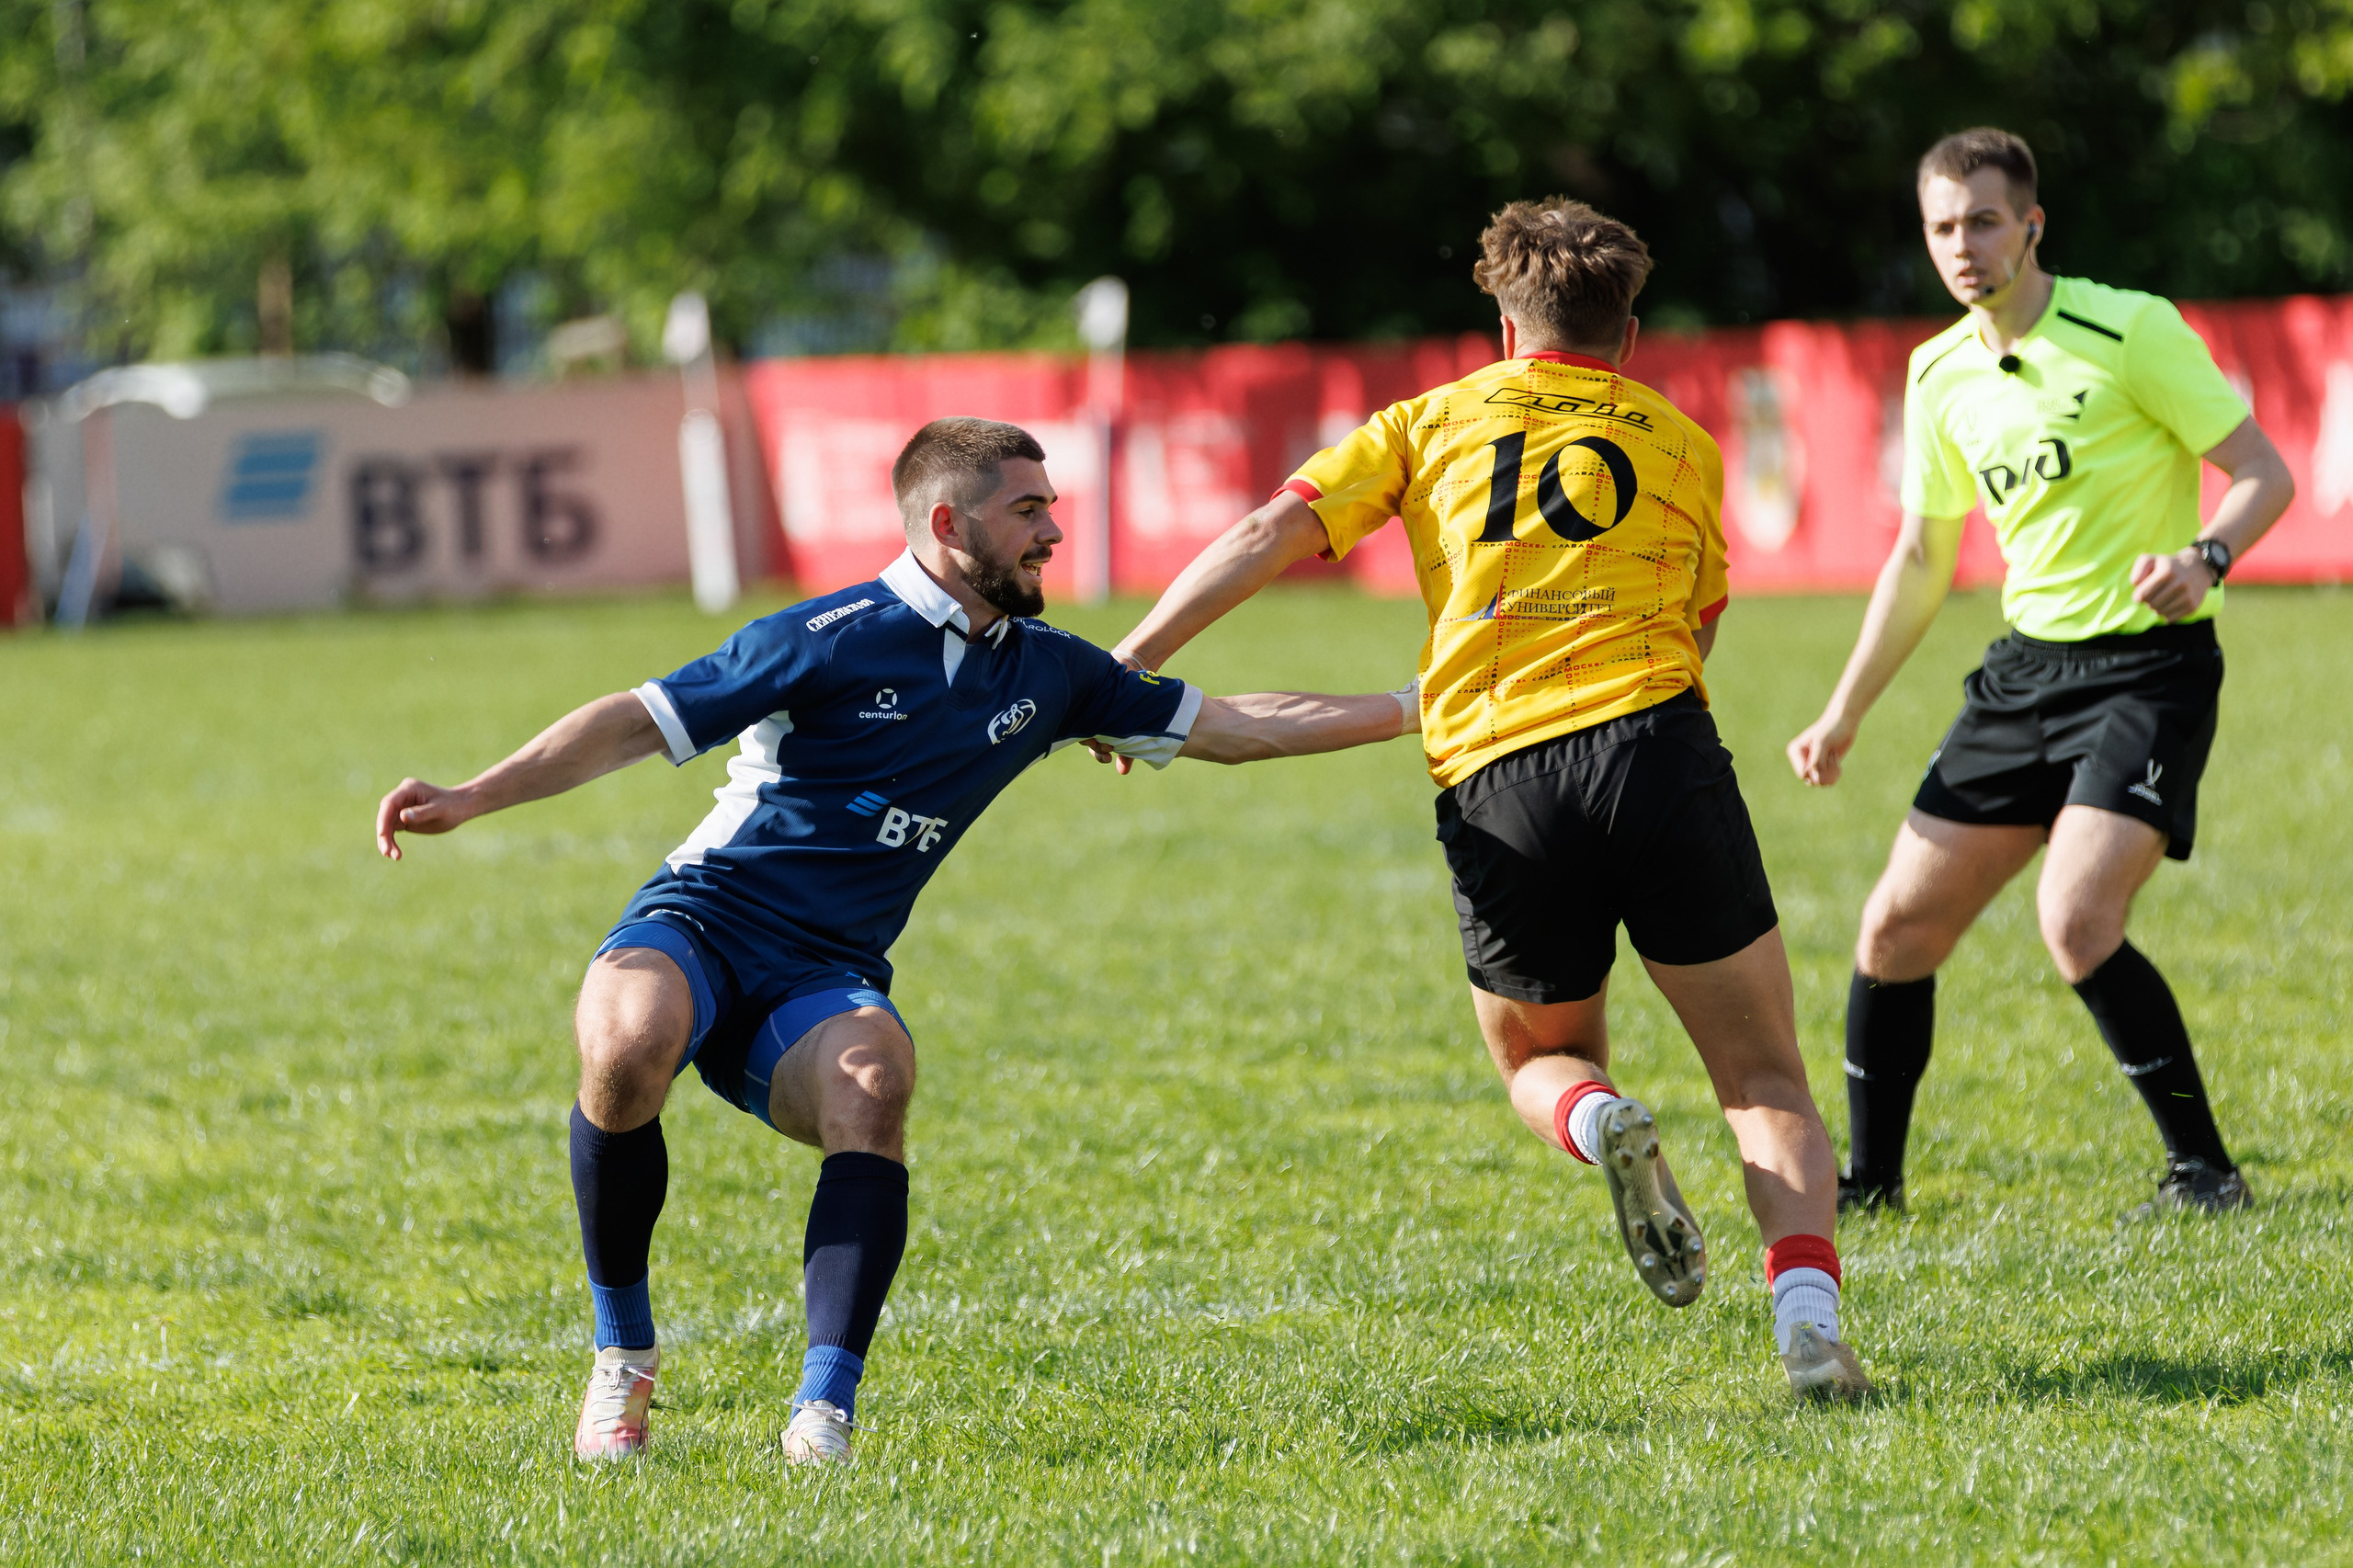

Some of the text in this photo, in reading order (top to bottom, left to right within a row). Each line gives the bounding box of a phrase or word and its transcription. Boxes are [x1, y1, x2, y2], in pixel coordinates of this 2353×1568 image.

[1472, 430, 1638, 542] 10
[349, 445, 603, 573] ВТБ
[1507, 586, 1616, 602] ФИНАНСОВЫЙ
[1507, 602, 1615, 616] УНИВЕРСИТЕТ
[858, 710, 908, 721] centurion
[875, 806, 949, 853] ВТБ
